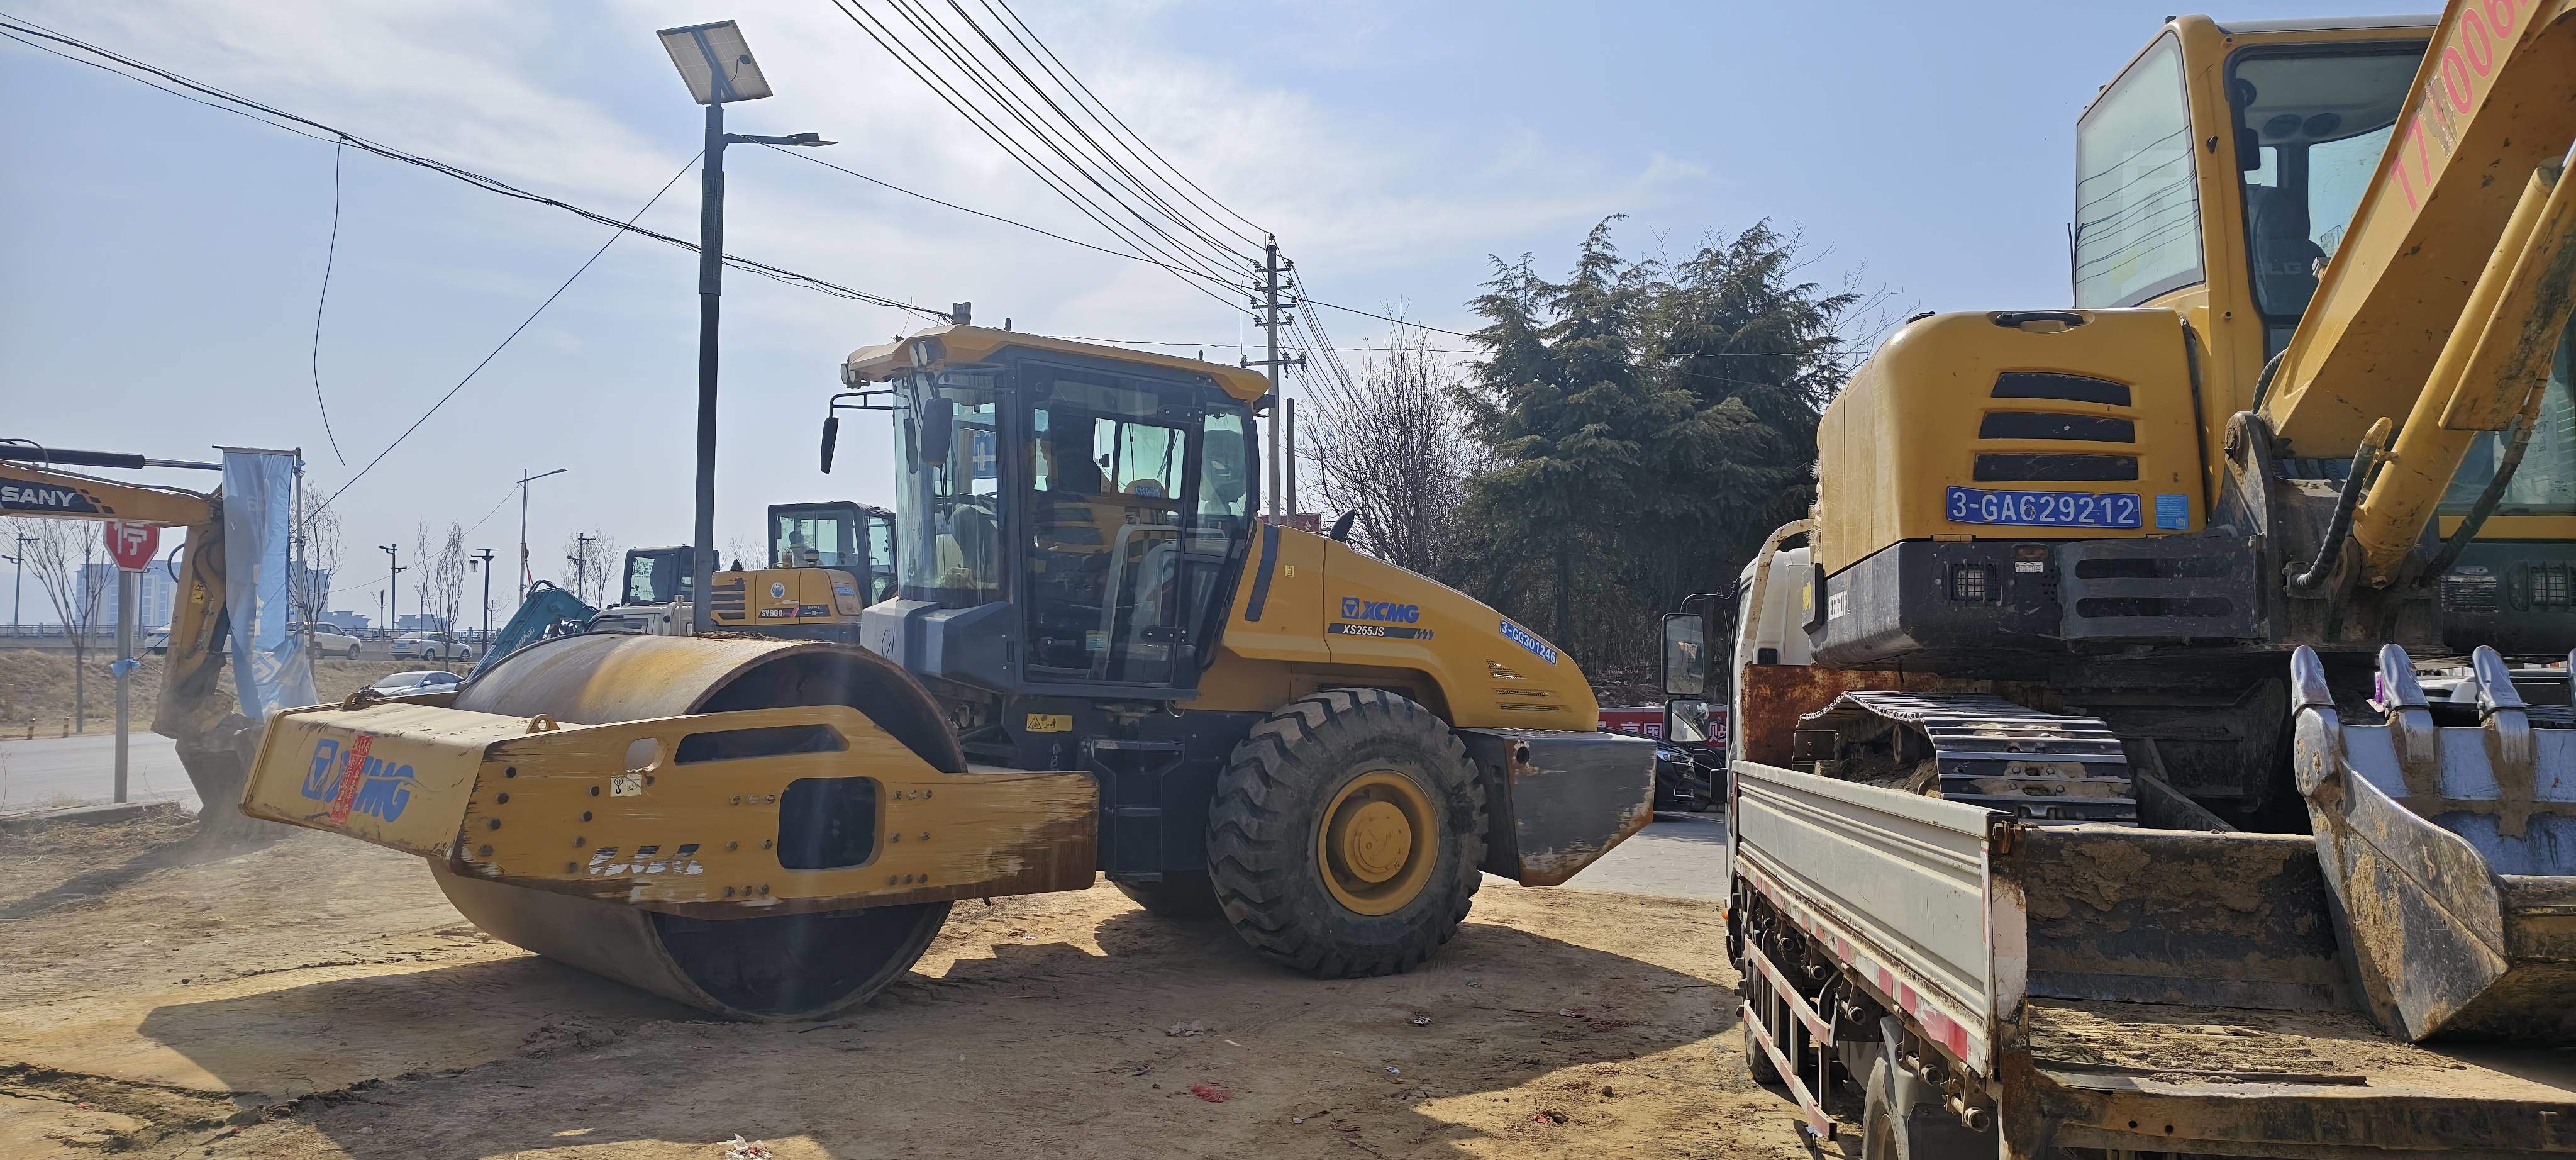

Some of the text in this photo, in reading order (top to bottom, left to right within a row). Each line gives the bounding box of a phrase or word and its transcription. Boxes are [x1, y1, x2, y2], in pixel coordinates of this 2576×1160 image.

[2390, 0, 2527, 213] 77006
[1, 486, 75, 506] SANY
[1952, 491, 2135, 523] 3-GA629212
[112, 520, 147, 556] 停
[1360, 601, 1419, 623] XCMG
[1342, 624, 1385, 637] XS265JS
[1501, 621, 1557, 664] 3-GG301246
